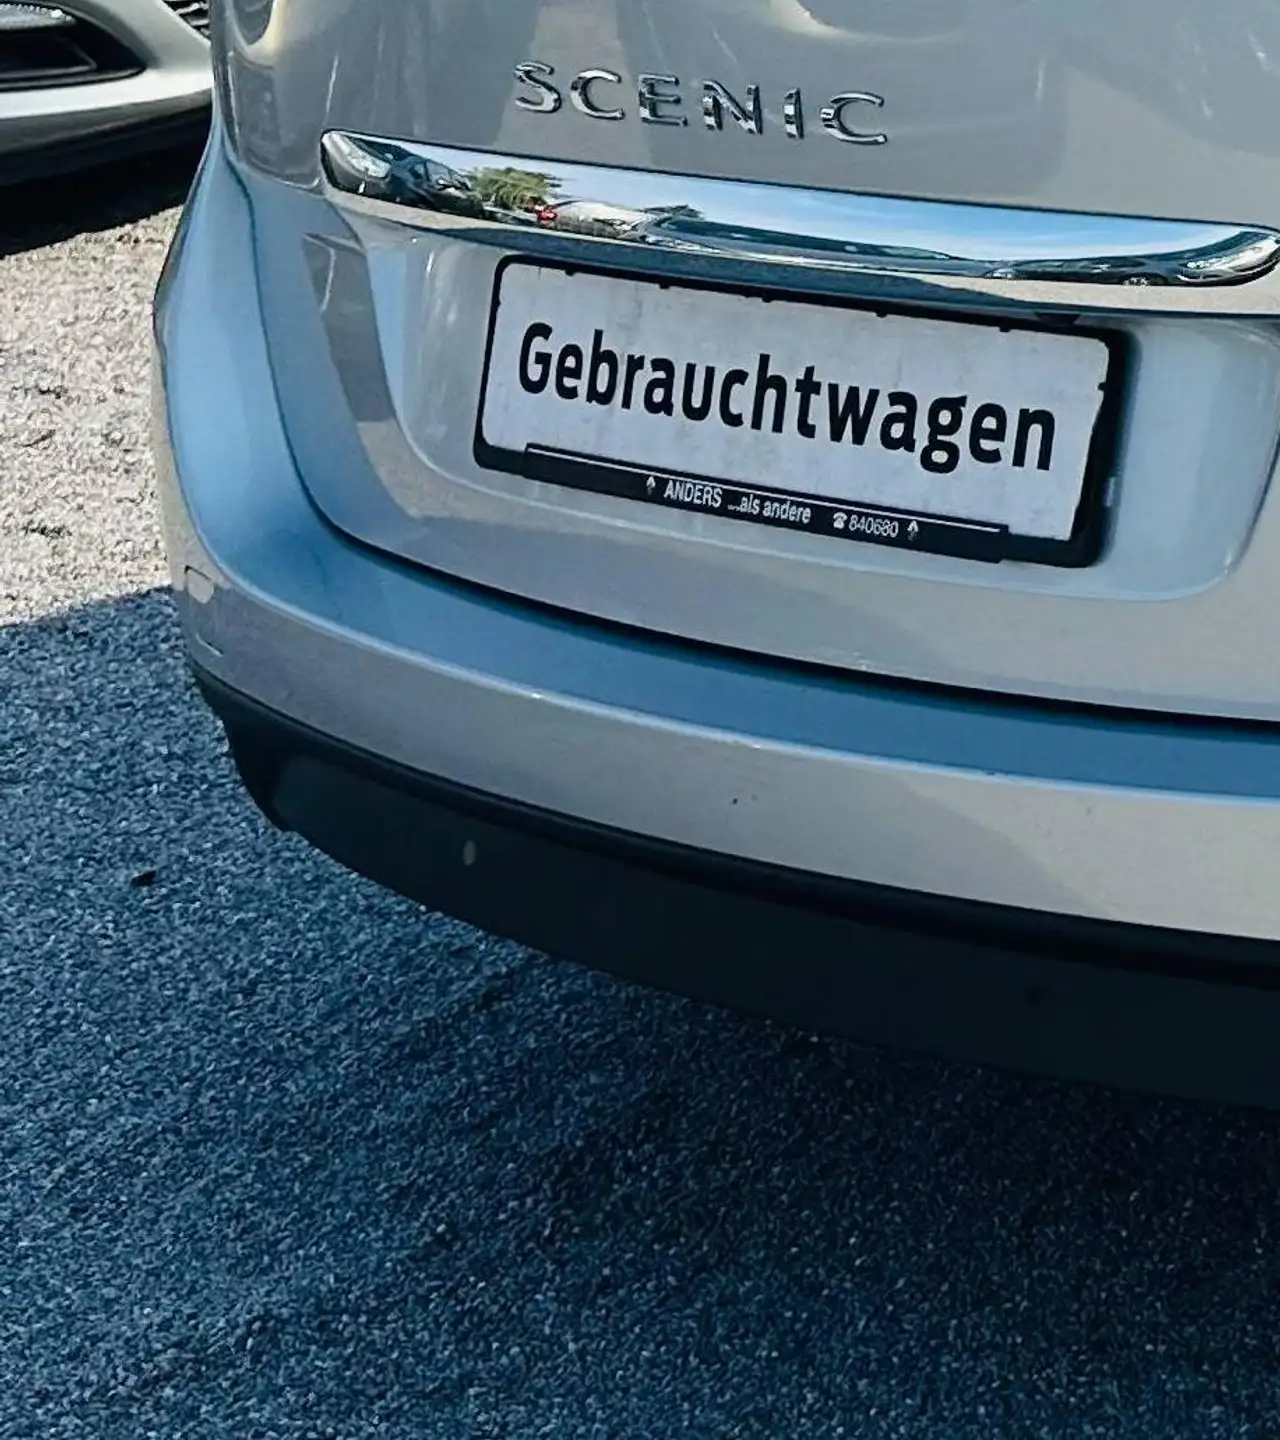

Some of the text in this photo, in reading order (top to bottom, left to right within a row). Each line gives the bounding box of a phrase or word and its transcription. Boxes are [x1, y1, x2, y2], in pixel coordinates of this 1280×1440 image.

[513, 60, 889, 145] SCENIC
[519, 322, 1057, 474] Gebrauchtwagen
[663, 478, 724, 509] ANDERS
[762, 499, 812, 525] andere
